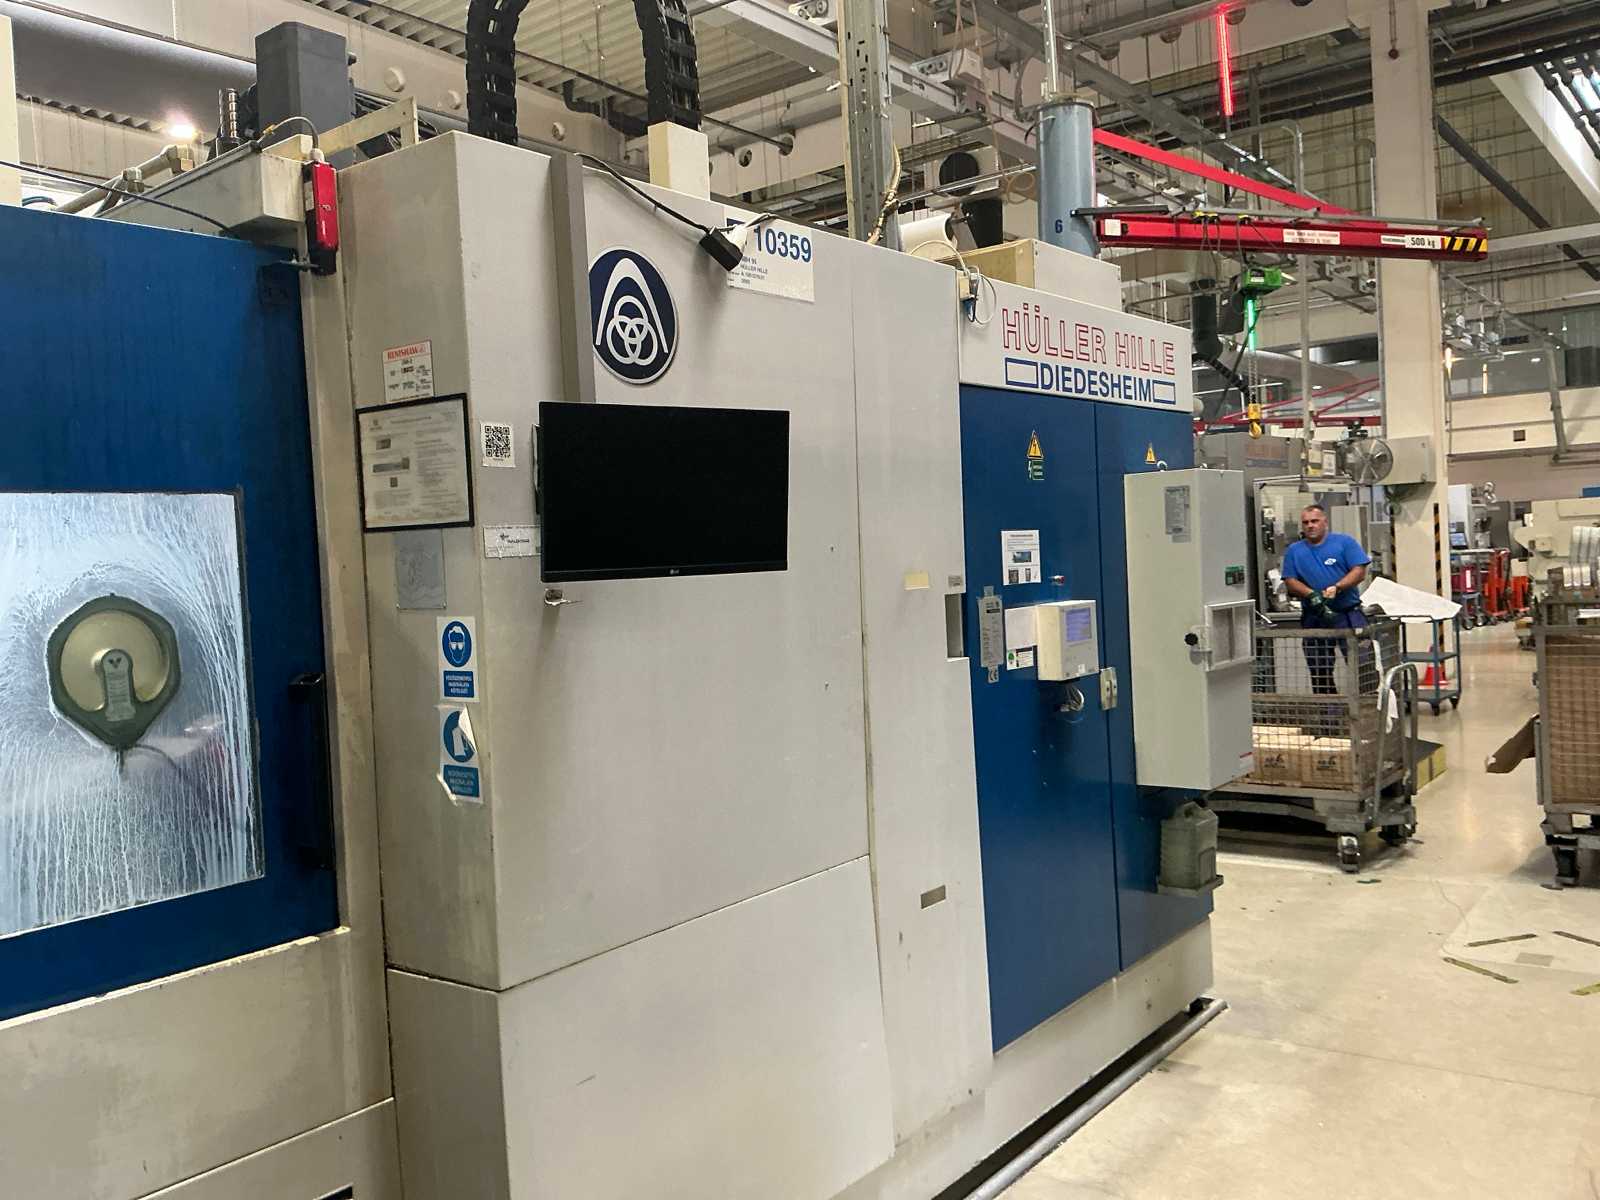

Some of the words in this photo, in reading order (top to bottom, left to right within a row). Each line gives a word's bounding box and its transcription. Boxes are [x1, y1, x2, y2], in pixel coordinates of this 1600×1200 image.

[754, 224, 811, 262] 10359
[1055, 219, 1063, 233] 6
[1411, 237, 1426, 247] 500
[1427, 239, 1436, 248] kg
[1002, 302, 1107, 365] HÜLLER
[1115, 331, 1176, 376] HILLE
[1039, 362, 1152, 403] DIEDESHEIM
